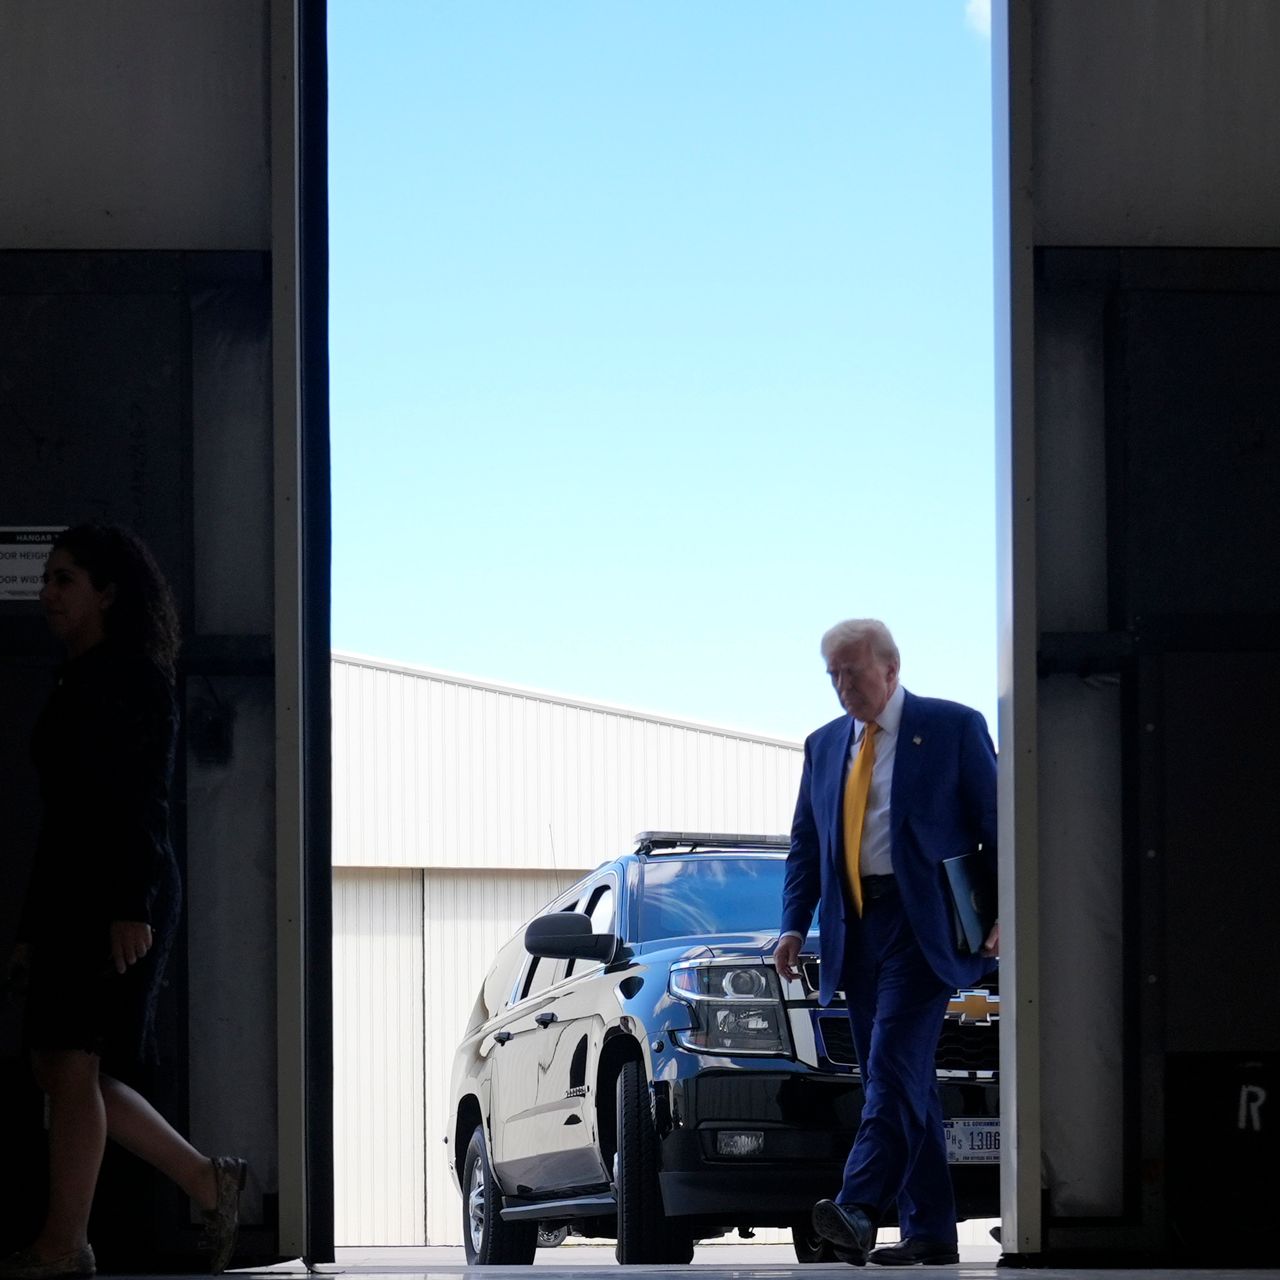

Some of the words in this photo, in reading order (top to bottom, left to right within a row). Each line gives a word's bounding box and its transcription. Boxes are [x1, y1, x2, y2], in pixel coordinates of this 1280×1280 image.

[16, 534, 52, 542] HANGAR
[19, 552, 50, 560] HEIGH
[1237, 1083, 1267, 1132] R
[969, 1131, 1000, 1150] 1306
